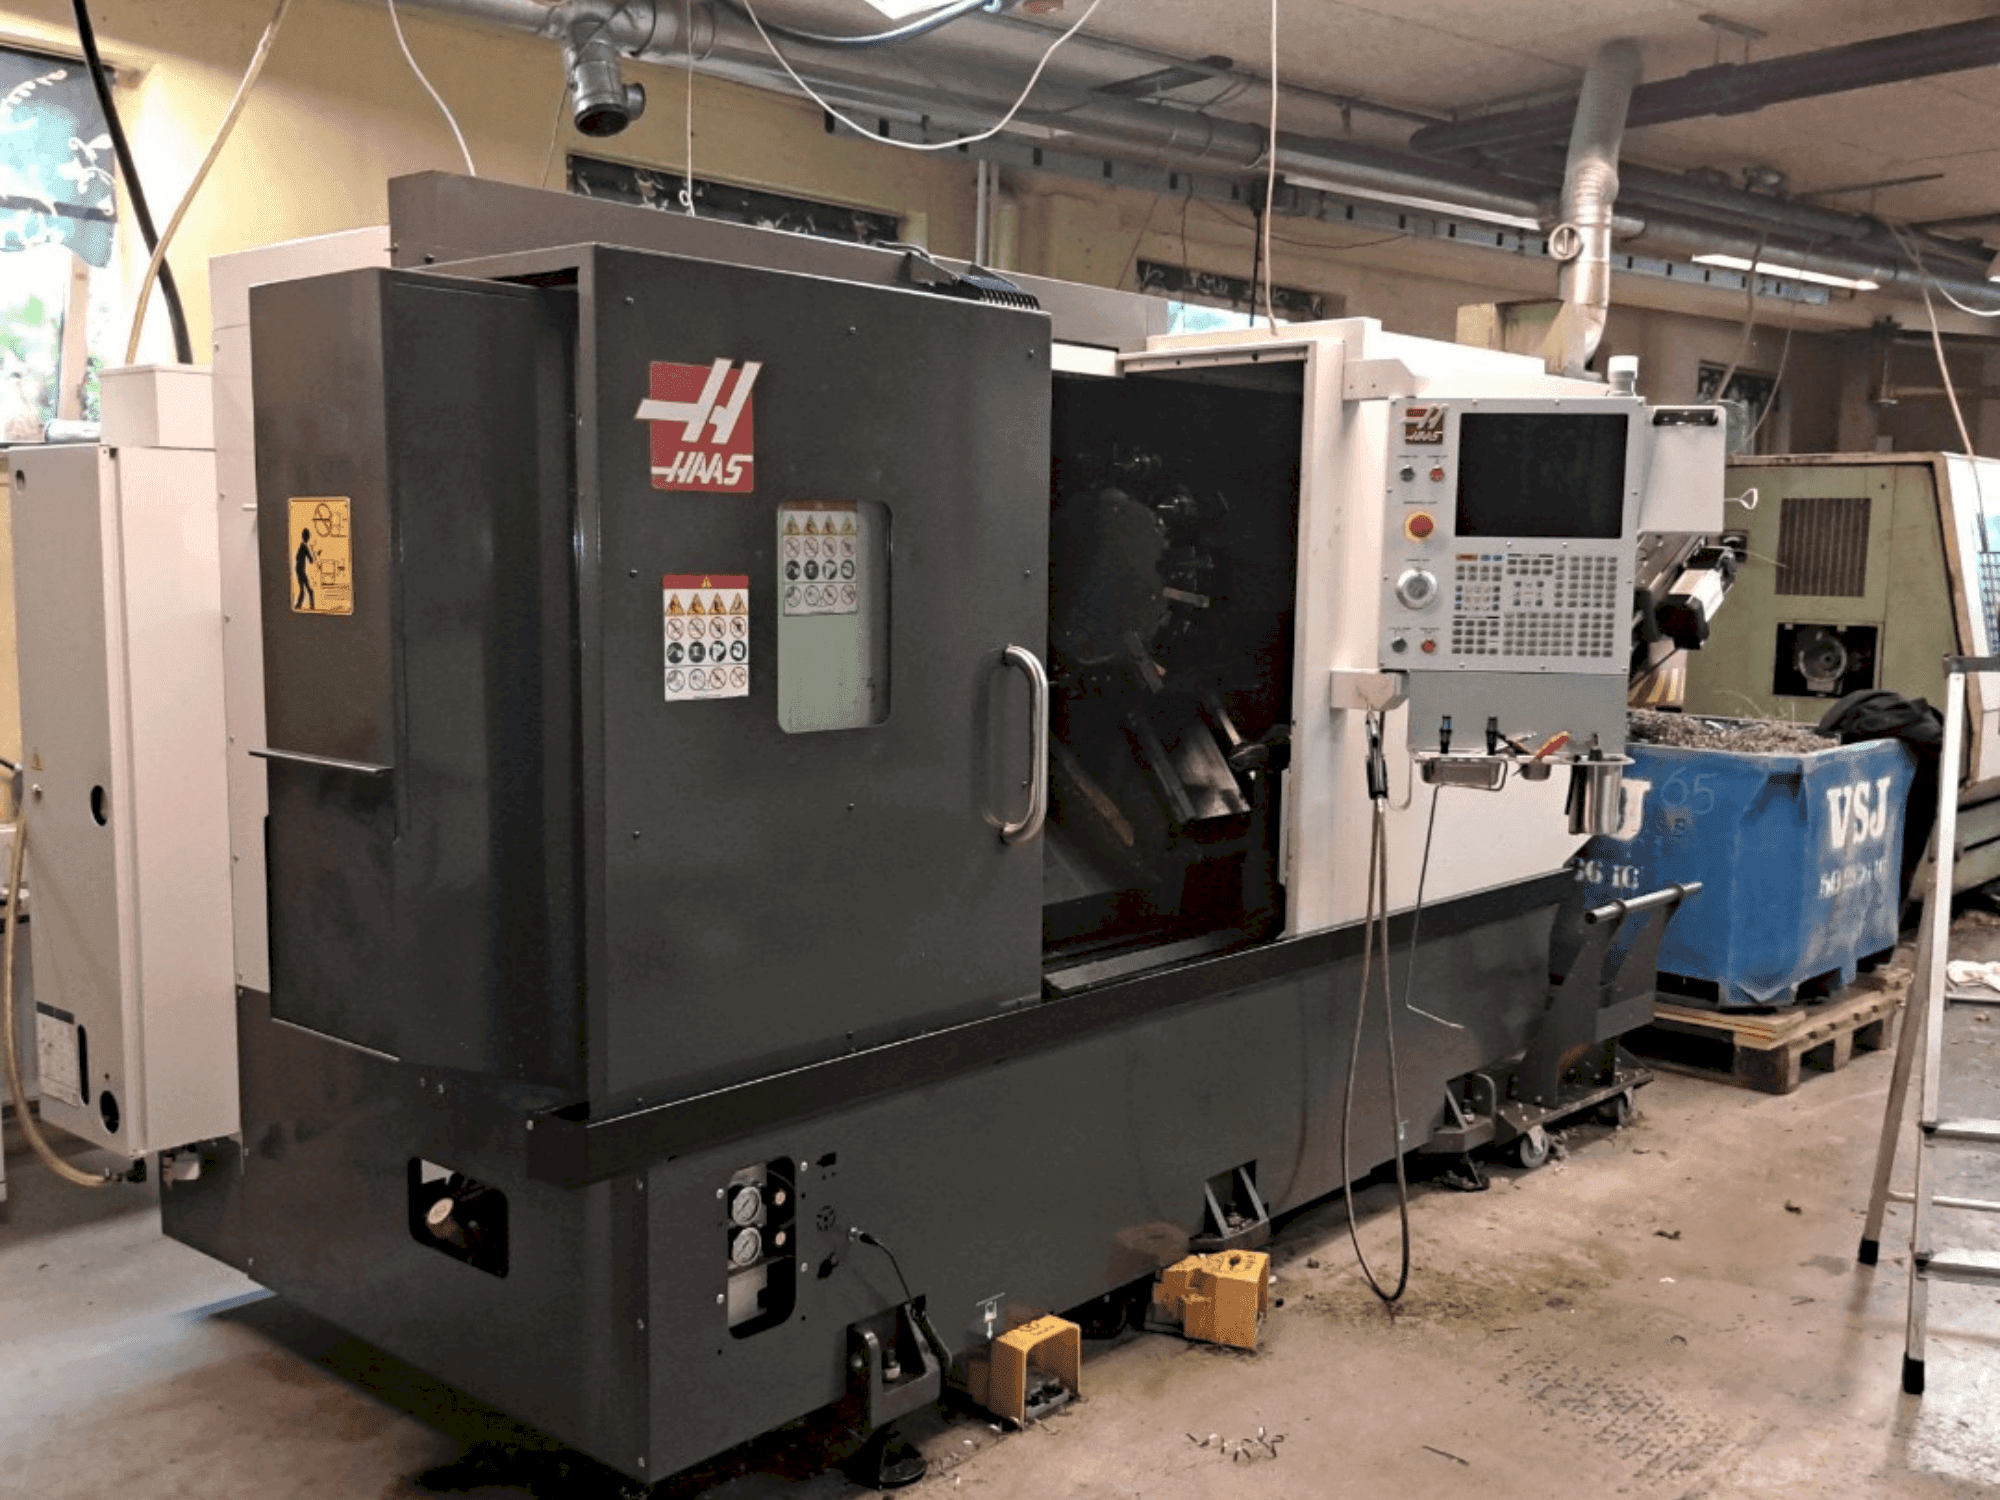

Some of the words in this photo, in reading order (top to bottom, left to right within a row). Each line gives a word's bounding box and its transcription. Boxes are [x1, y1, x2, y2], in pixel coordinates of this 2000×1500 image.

[650, 450, 754, 487] HAAS
[1660, 766, 1717, 815] 65
[1826, 776, 1891, 850] VSJ
